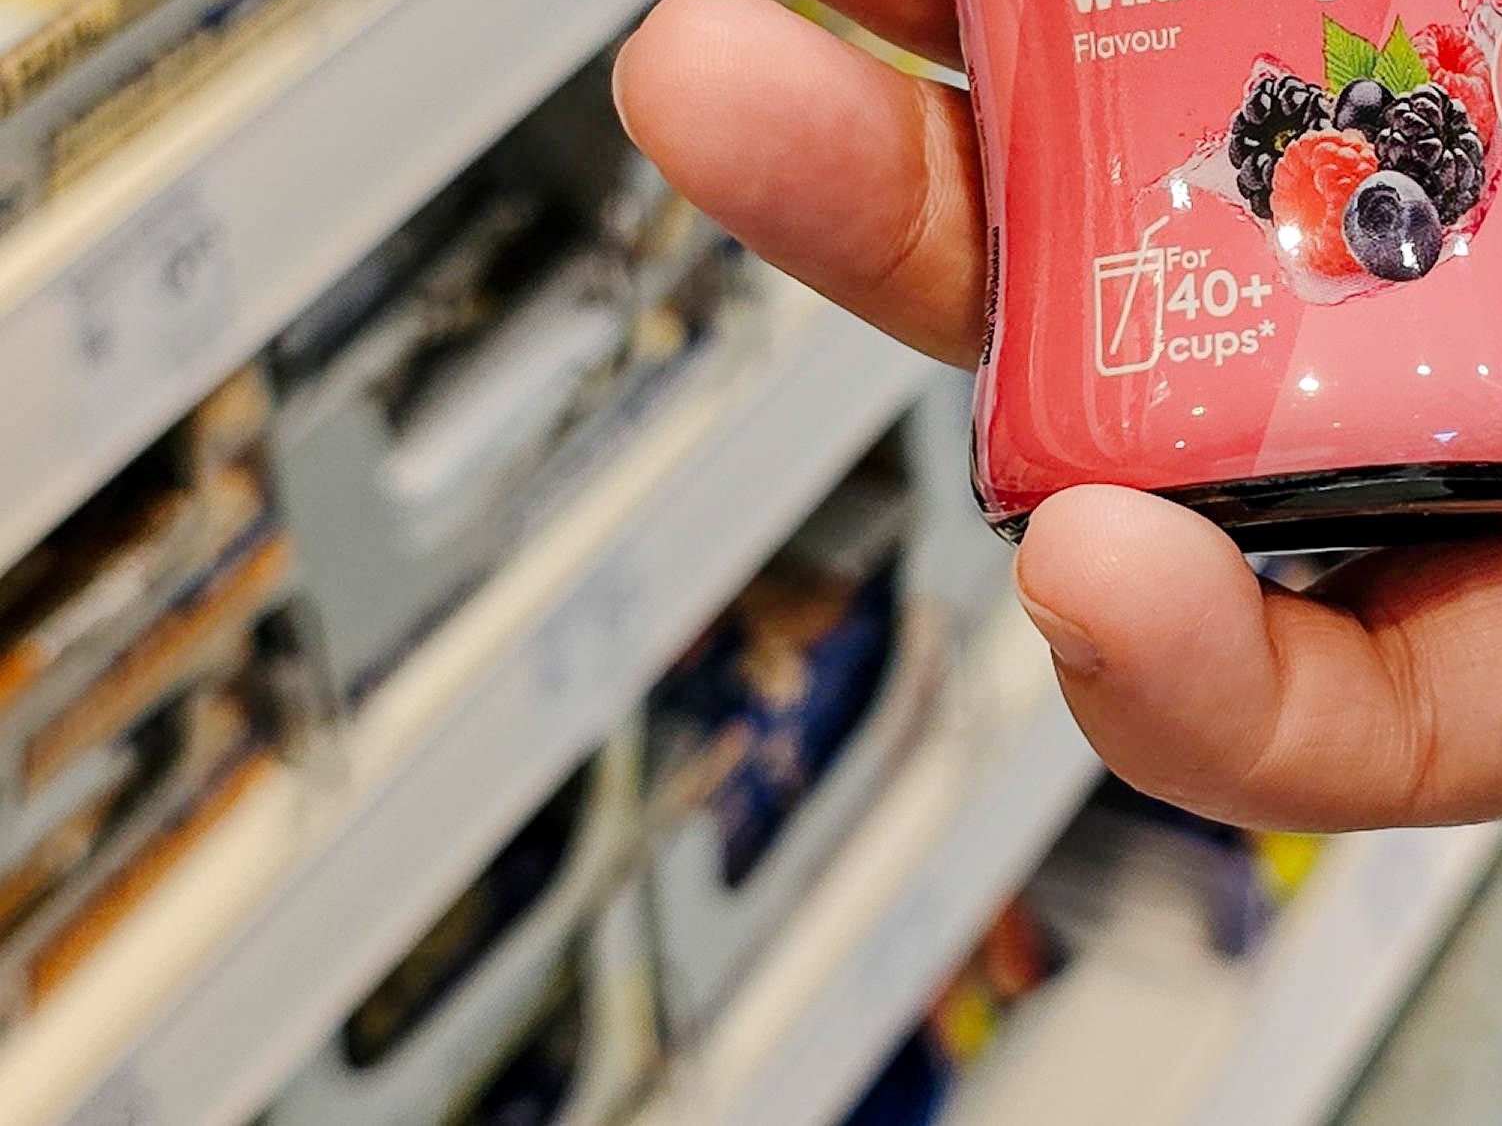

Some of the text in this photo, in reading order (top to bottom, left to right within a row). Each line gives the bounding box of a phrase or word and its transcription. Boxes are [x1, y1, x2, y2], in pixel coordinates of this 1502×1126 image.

[1073, 26, 1182, 62] Flavour
[1165, 246, 1212, 271] For
[1166, 269, 1272, 320] 40+
